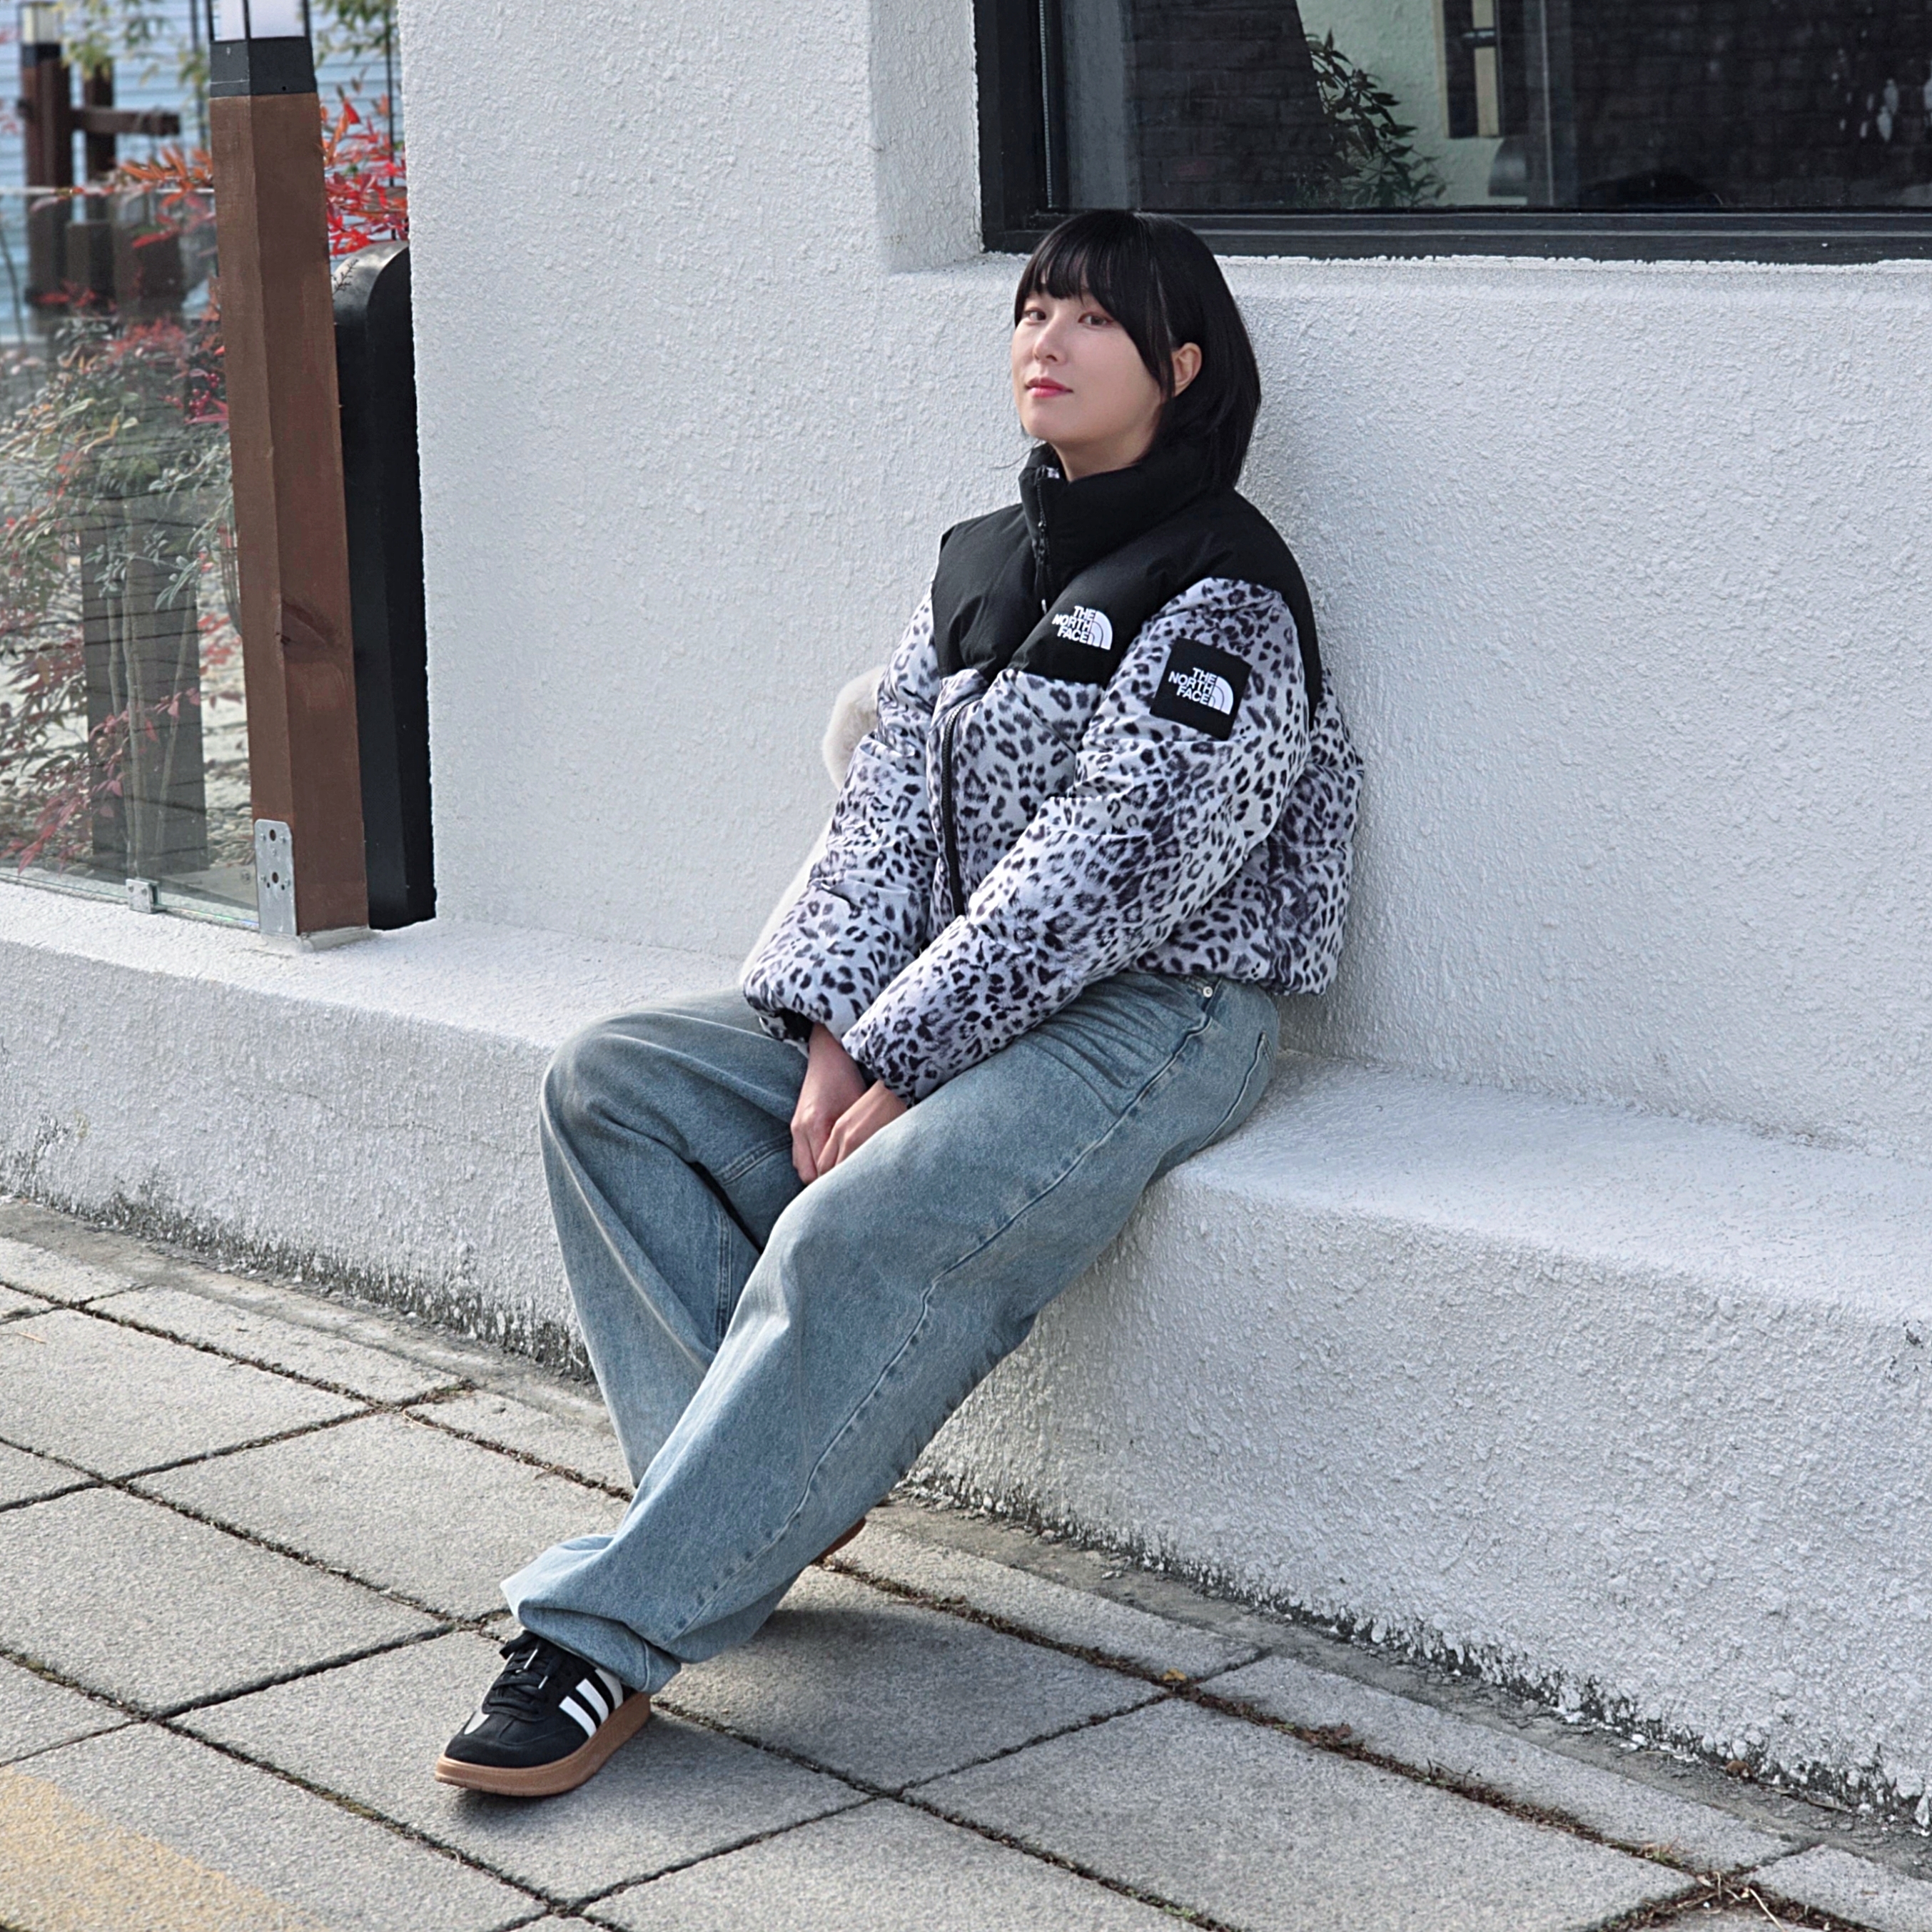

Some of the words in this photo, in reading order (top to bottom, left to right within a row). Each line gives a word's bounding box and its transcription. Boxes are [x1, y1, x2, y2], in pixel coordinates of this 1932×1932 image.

[1073, 605, 1096, 619] THE
[1052, 614, 1091, 631] NORTH
[1057, 627, 1089, 644] FACE
[1168, 671, 1213, 693] NORTH
[1192, 667, 1218, 683] THE
[1176, 687, 1210, 705] FACE
